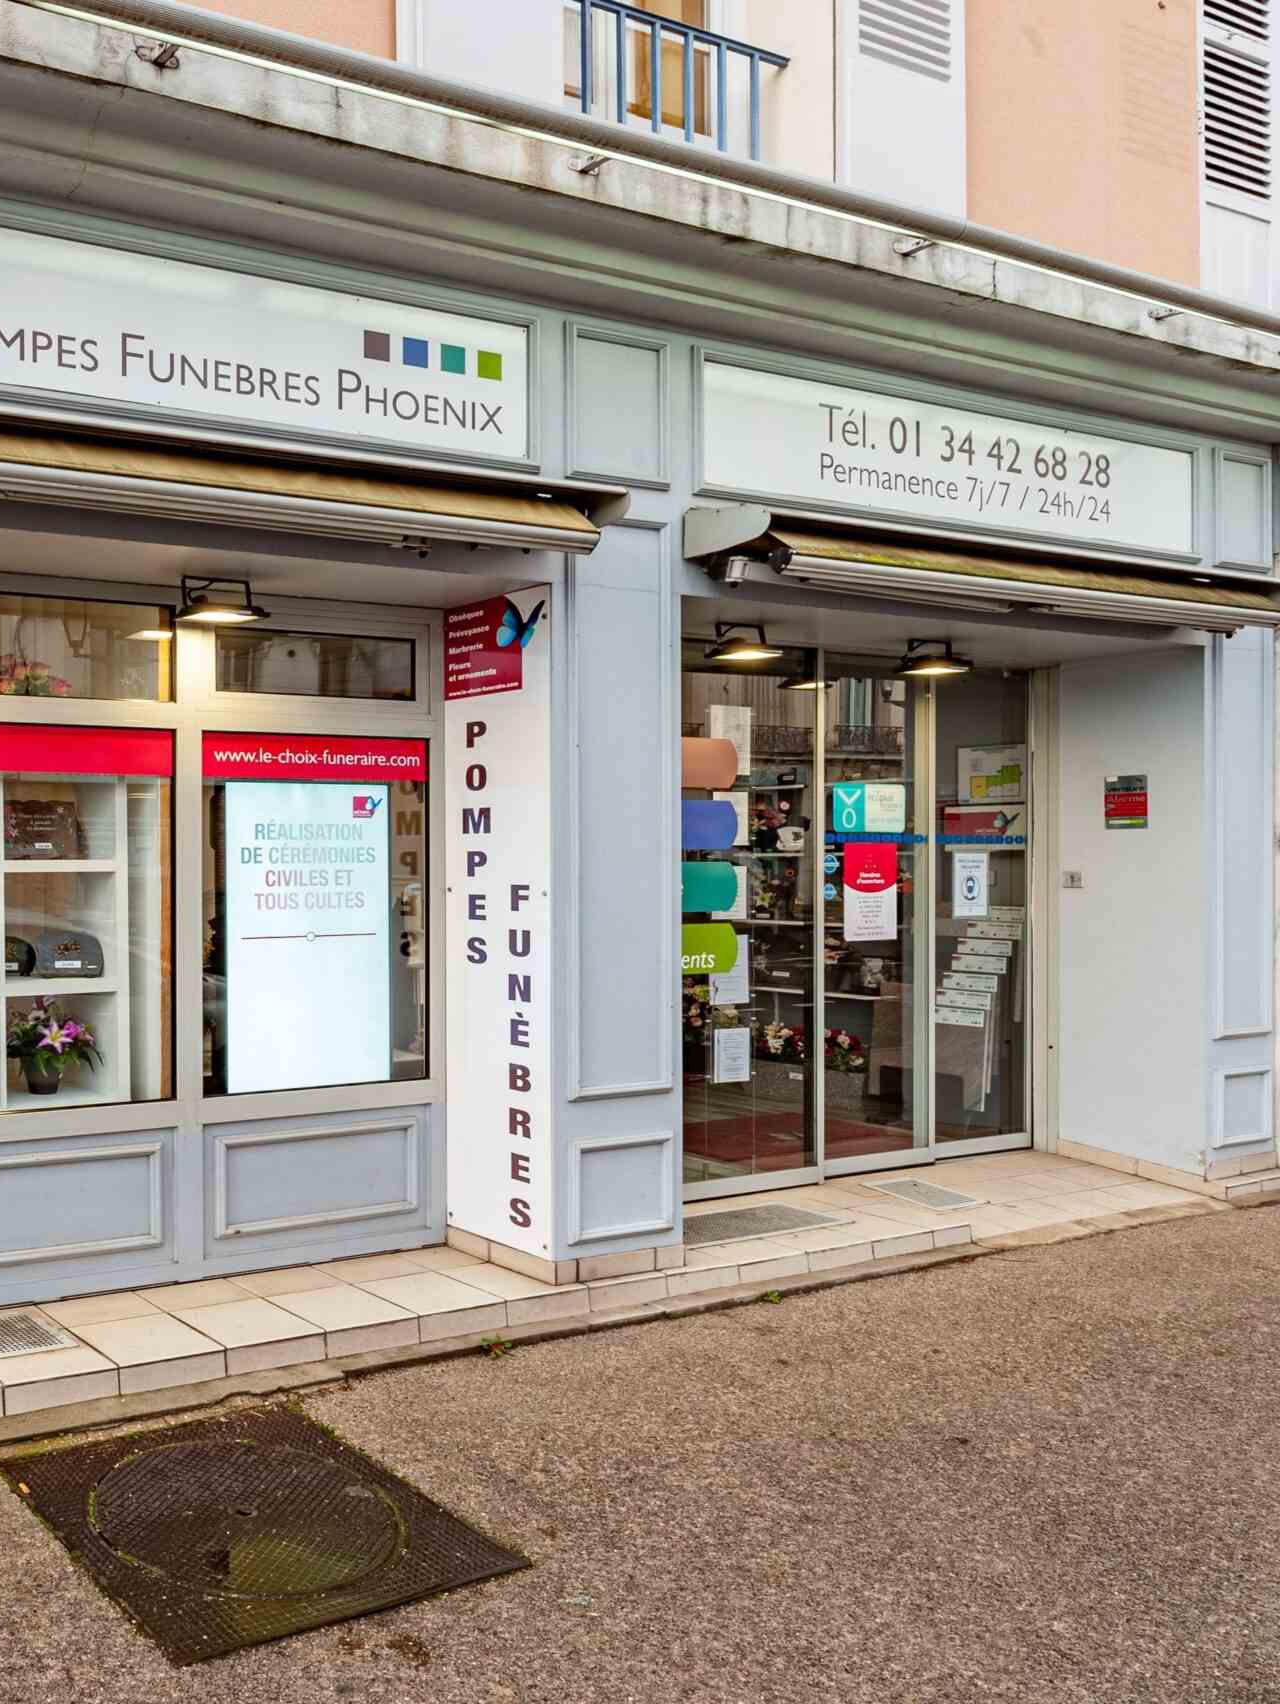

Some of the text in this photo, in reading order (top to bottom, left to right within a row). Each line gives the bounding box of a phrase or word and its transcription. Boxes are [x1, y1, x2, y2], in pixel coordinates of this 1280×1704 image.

[120, 333, 321, 407] FUNEBRES
[337, 368, 504, 434] PHOENIX
[820, 405, 1111, 488] Tél. 01 34 42 68 28
[820, 453, 960, 500] Permanence
[965, 476, 1010, 512] 7j/7
[1037, 487, 1111, 523] 24h/24
[213, 748, 420, 768] www.le-choix-funeraire.com
[254, 820, 363, 840] RÉALISATION
[462, 721, 491, 964] POMPES
[240, 843, 376, 864] DE CÉRÉMONIES
[265, 869, 353, 887] CIVILES ET
[254, 891, 365, 911] TOUS CULTES
[508, 884, 531, 1228] FUNÈBRES
